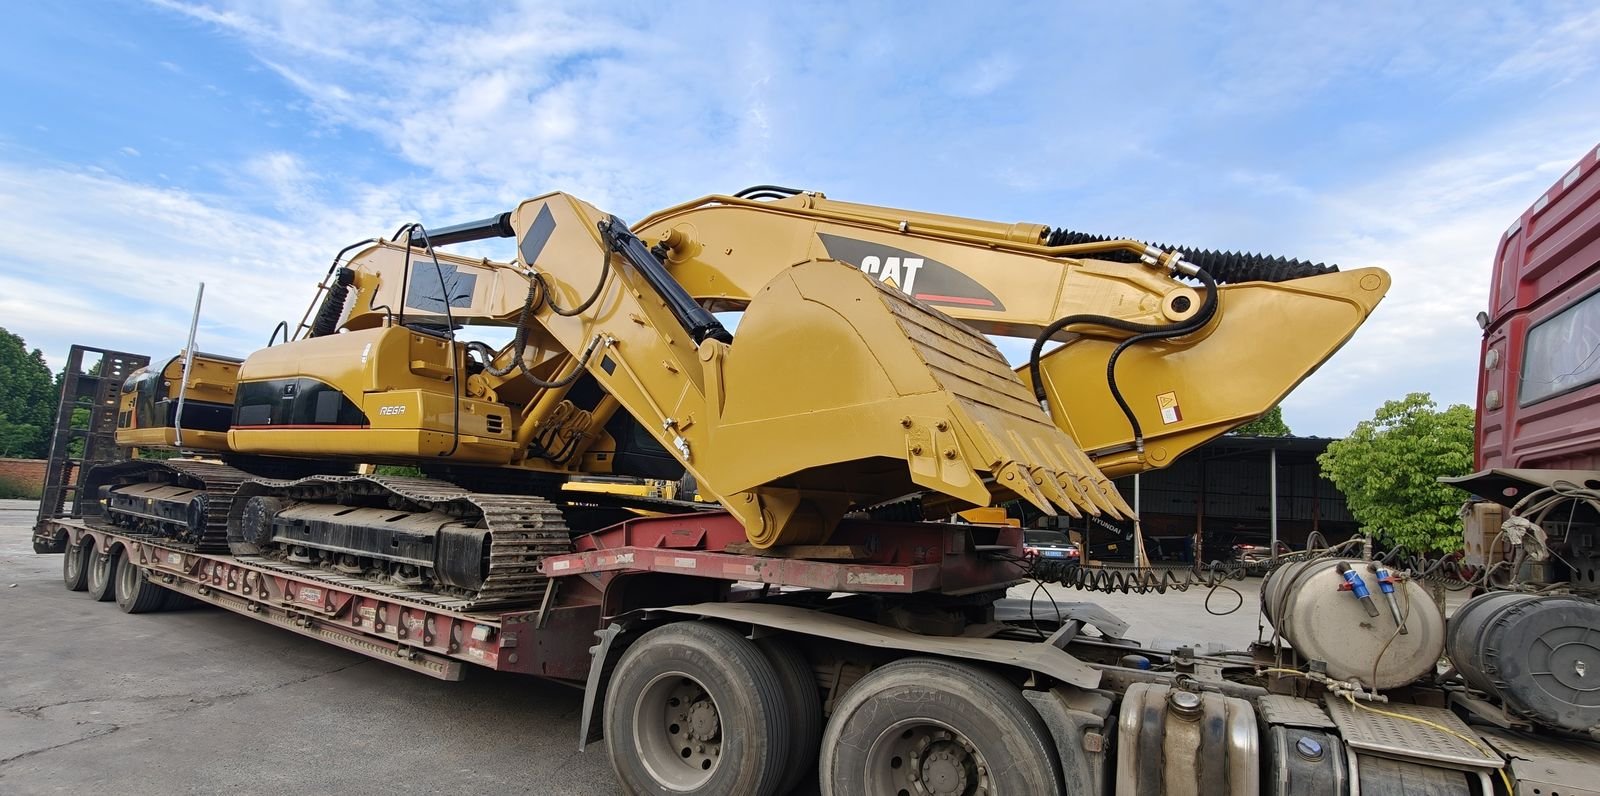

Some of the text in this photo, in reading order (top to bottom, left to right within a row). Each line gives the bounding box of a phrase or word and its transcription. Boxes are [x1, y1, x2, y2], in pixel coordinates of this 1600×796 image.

[860, 256, 925, 296] CAT
[379, 405, 406, 416] REGA
[1091, 516, 1122, 535] HYUNDAI
